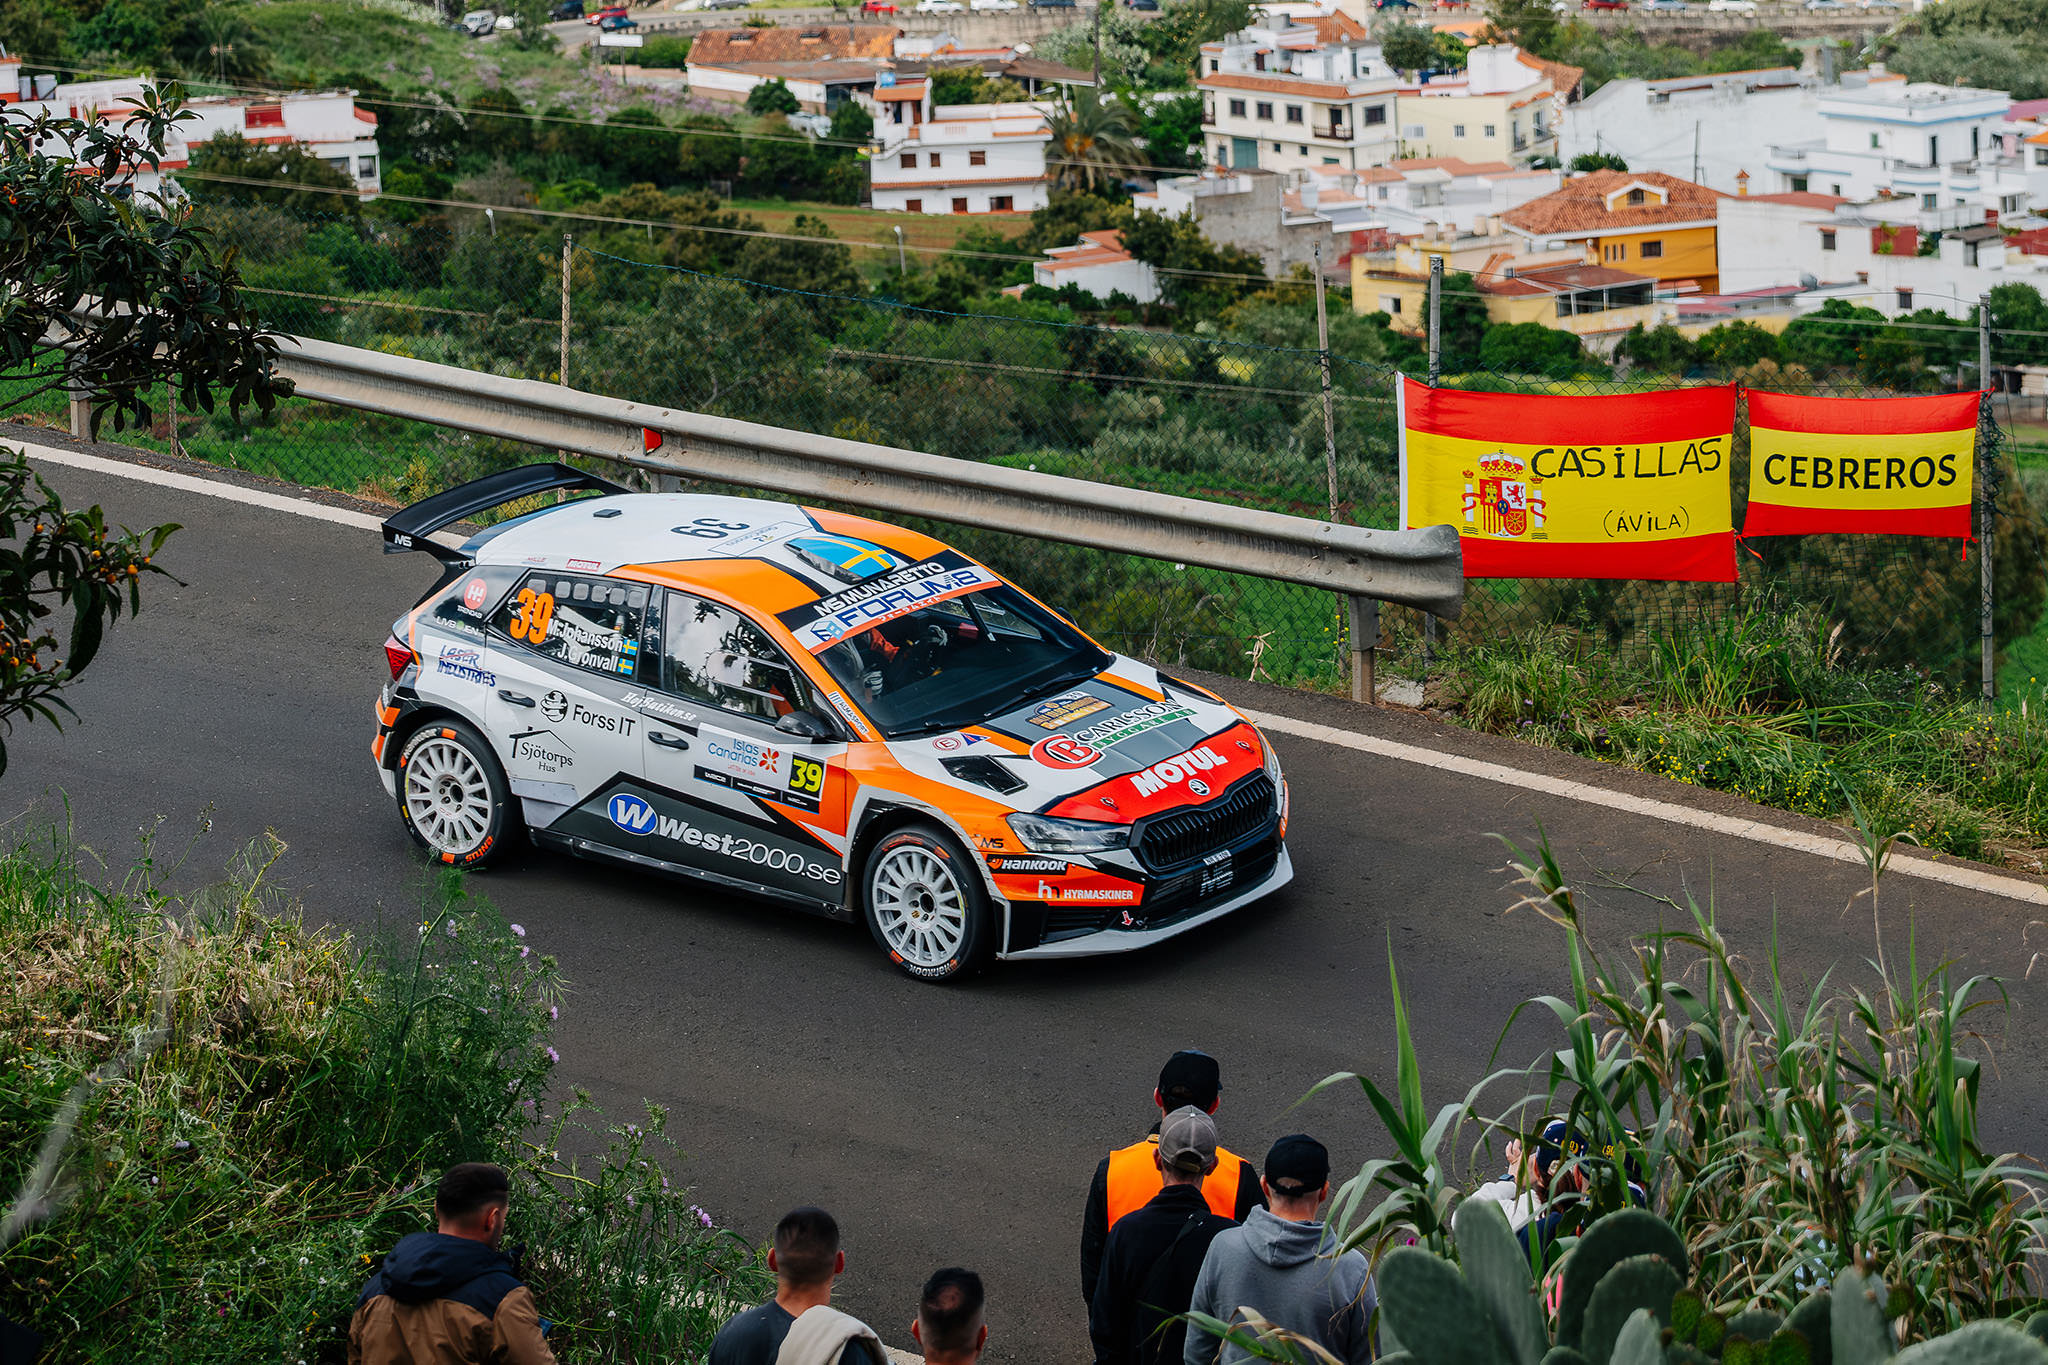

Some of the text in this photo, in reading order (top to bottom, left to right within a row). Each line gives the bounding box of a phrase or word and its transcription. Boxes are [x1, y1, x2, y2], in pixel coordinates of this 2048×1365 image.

[1764, 453, 1957, 489] CEBREROS
[670, 518, 750, 539] 39
[840, 562, 946, 605] MUNARETTO
[510, 588, 554, 644] 39
[437, 660, 497, 688] INDUSTRIES
[573, 704, 636, 737] Forss IT
[1075, 700, 1184, 742] CARLSSON
[521, 742, 573, 768] Sjötorps
[708, 742, 758, 767] Canarias
[733, 739, 760, 756] Islas
[538, 761, 556, 773] Hus
[790, 758, 823, 793] 39
[1129, 746, 1229, 798] MOTUL
[657, 814, 842, 885] West2000.se
[1064, 888, 1134, 900] HYRMASKINER
